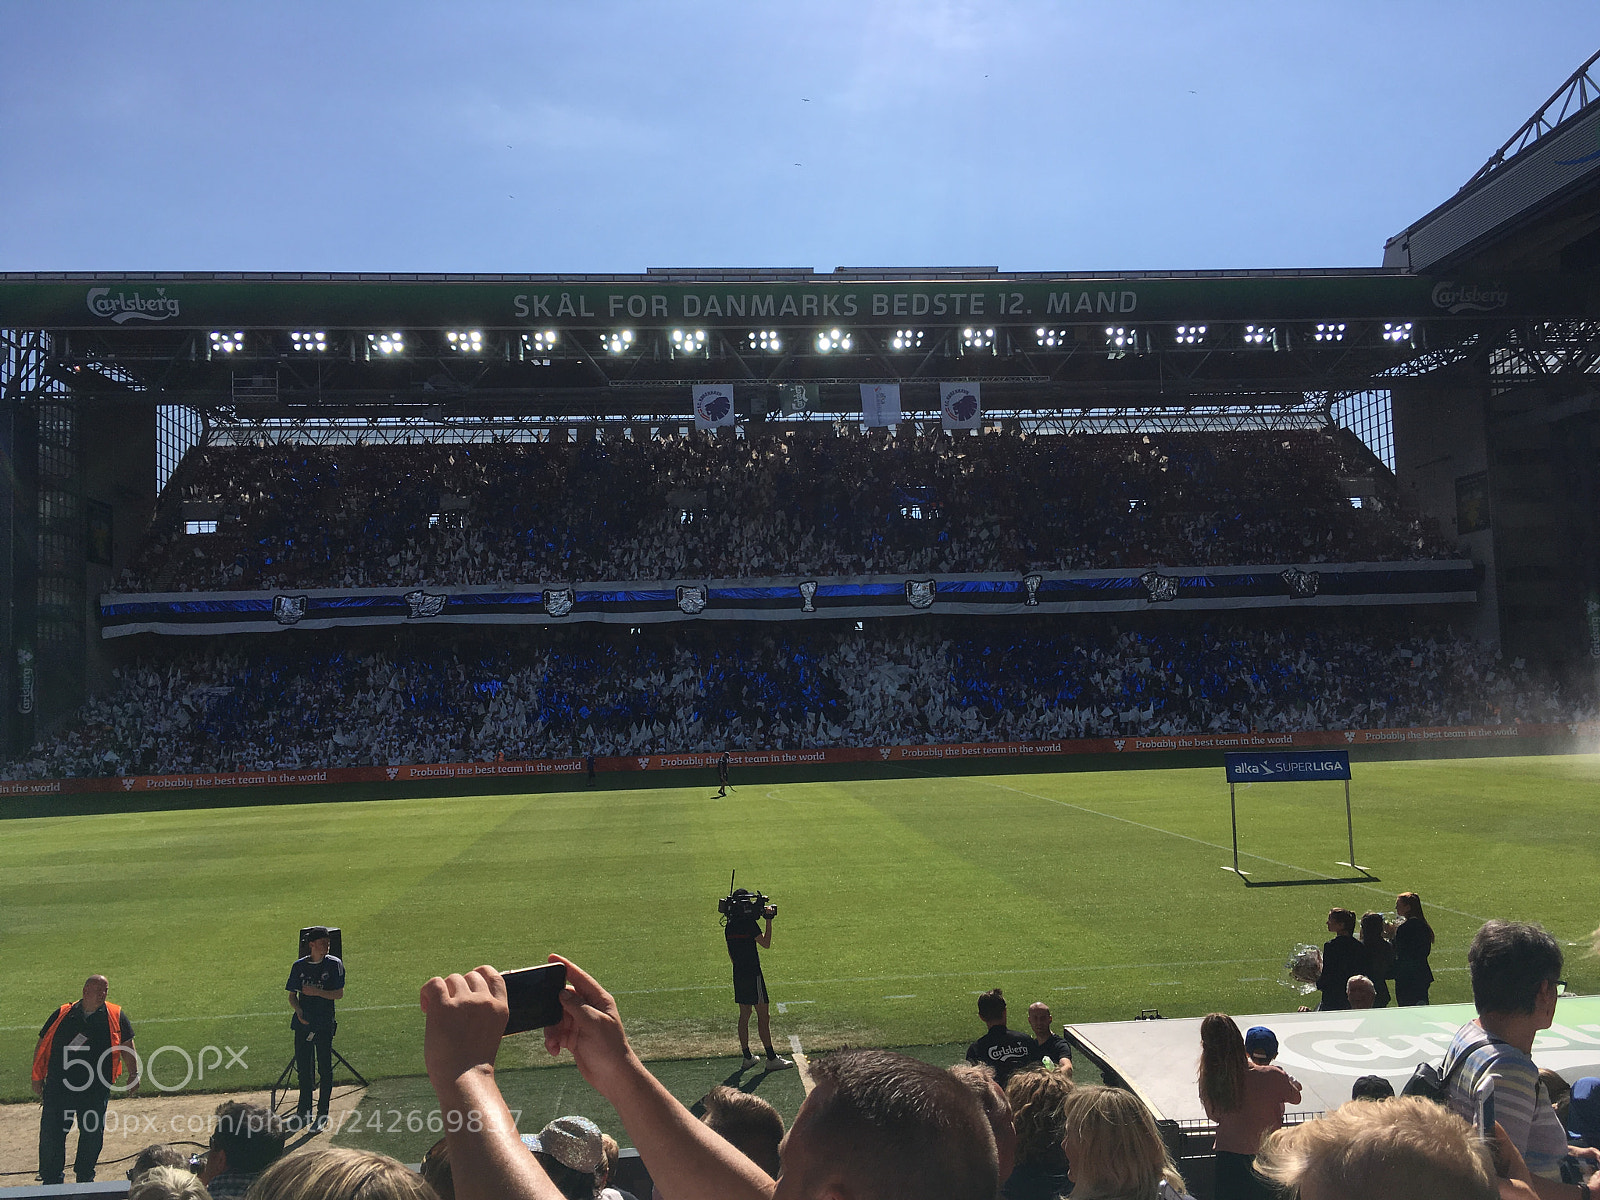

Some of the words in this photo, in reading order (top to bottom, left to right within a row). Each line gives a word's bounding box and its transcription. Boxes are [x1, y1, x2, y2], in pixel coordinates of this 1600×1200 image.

[513, 292, 595, 317] SKÅL
[608, 295, 668, 317] FOR
[683, 294, 858, 317] DANMARKS
[872, 293, 985, 316] BEDSTE
[999, 292, 1032, 315] 12.
[1046, 291, 1138, 314] MAND
[1431, 281, 1509, 313] Carlsberg
[86, 287, 180, 324] Carlsberg
[1366, 732, 1405, 741] Probably
[1408, 731, 1422, 739] the
[1424, 730, 1442, 739] best
[1444, 730, 1466, 738] team
[1468, 729, 1477, 737] in
[1478, 728, 1492, 736] the
[1494, 727, 1519, 736] world
[1136, 740, 1176, 749] Probably
[1178, 739, 1192, 747] the
[1194, 738, 1214, 746] best
[1216, 738, 1239, 746] team
[1241, 737, 1249, 745] in
[1251, 736, 1265, 744] the
[1267, 735, 1293, 744] world
[902, 748, 943, 758] Probably
[946, 747, 960, 756] the
[962, 747, 981, 755] best
[983, 746, 1007, 754] team
[1009, 745, 1017, 753] in
[1019, 745, 1034, 753] the
[1036, 743, 1062, 752] world
[660, 757, 703, 767] Probably
[723, 755, 743, 764] est
[745, 755, 769, 763] team
[771, 753, 780, 762] in
[782, 753, 797, 761] the
[799, 752, 826, 761] world
[410, 767, 455, 777] Probably
[457, 766, 473, 775] the
[475, 765, 496, 774] best
[498, 766, 523, 774] team
[525, 764, 535, 772] in
[537, 763, 552, 772] the
[554, 762, 582, 771] world
[1235, 762, 1259, 774] alka
[1275, 761, 1343, 772] SUPERLIGA
[146, 777, 193, 789] Probably
[196, 776, 212, 786] the
[214, 776, 236, 785] best
[238, 777, 265, 785] team
[267, 774, 277, 783] in
[279, 773, 295, 782] the
[298, 771, 327, 782] world
[12, 784, 29, 793] the
[31, 783, 61, 792] world
[988, 1044, 1028, 1061] Carlsberg
